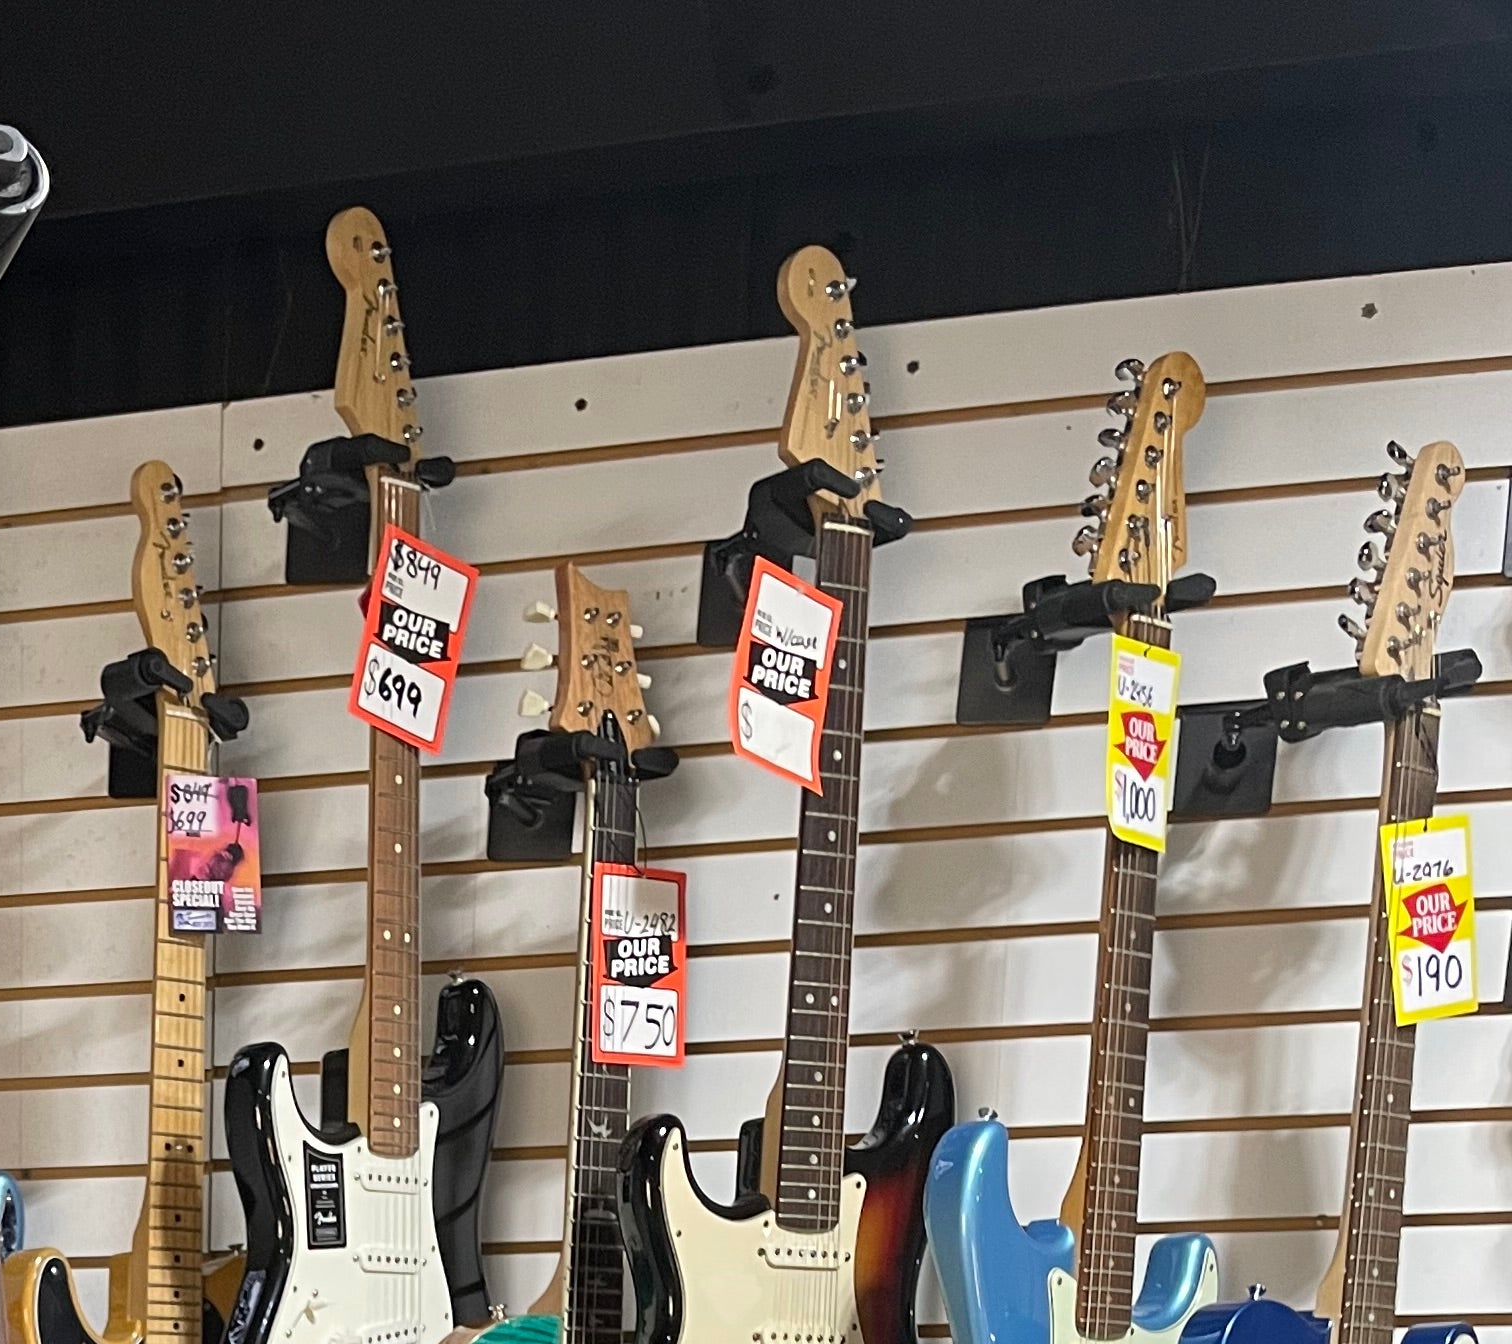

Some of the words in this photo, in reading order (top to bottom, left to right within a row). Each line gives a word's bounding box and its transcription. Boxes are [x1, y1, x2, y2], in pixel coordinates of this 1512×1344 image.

[390, 540, 442, 591] $849
[392, 608, 437, 639] OUR
[381, 623, 445, 659] PRICE
[761, 648, 806, 677] OUR
[364, 656, 422, 719] $699
[751, 664, 812, 699] PRICE
[1128, 716, 1156, 743] OUR
[1124, 735, 1159, 764] PRICE
[1115, 769, 1156, 824] $1,000
[168, 806, 207, 834] $699
[171, 879, 225, 895] CLOSEOUT
[172, 893, 220, 908] SPECIAL!
[1415, 891, 1451, 916] OUR
[1411, 911, 1458, 938] PRICE
[617, 937, 661, 958] OUR
[610, 955, 670, 979] PRICE
[1401, 953, 1463, 997] $190
[603, 998, 676, 1050] $750
